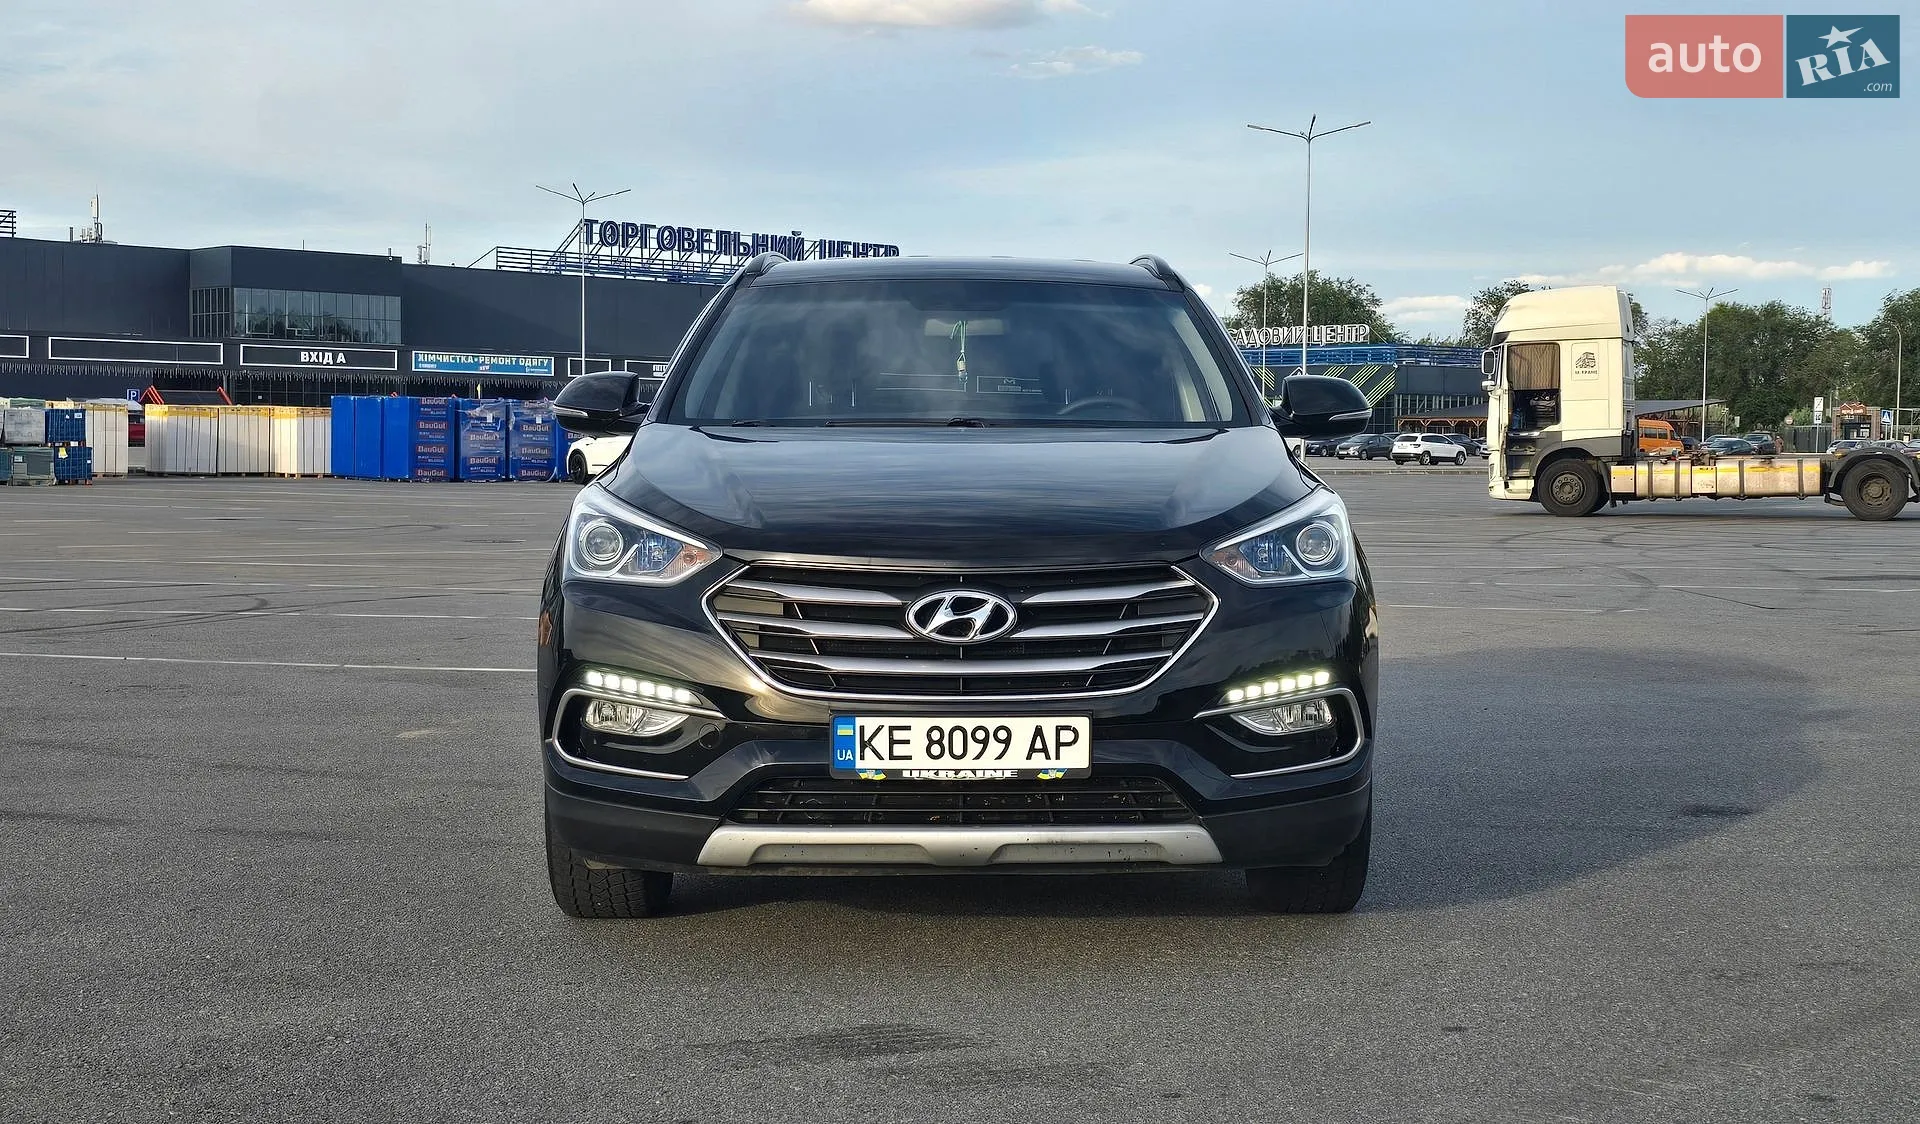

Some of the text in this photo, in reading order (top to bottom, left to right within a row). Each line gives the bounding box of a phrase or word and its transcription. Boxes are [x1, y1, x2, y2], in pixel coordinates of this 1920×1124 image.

[582, 217, 805, 261] ТОРГОВЕЛЬНИЙ
[1311, 324, 1370, 347] ЦЕНТР
[300, 351, 334, 365] ВХІД
[479, 356, 517, 366] РЕМОНТ
[519, 358, 549, 367] ОДЯГУ
[859, 724, 1080, 761] KE 8099 AP
[837, 749, 854, 761] UA
[902, 769, 1019, 778] UKRAINE
